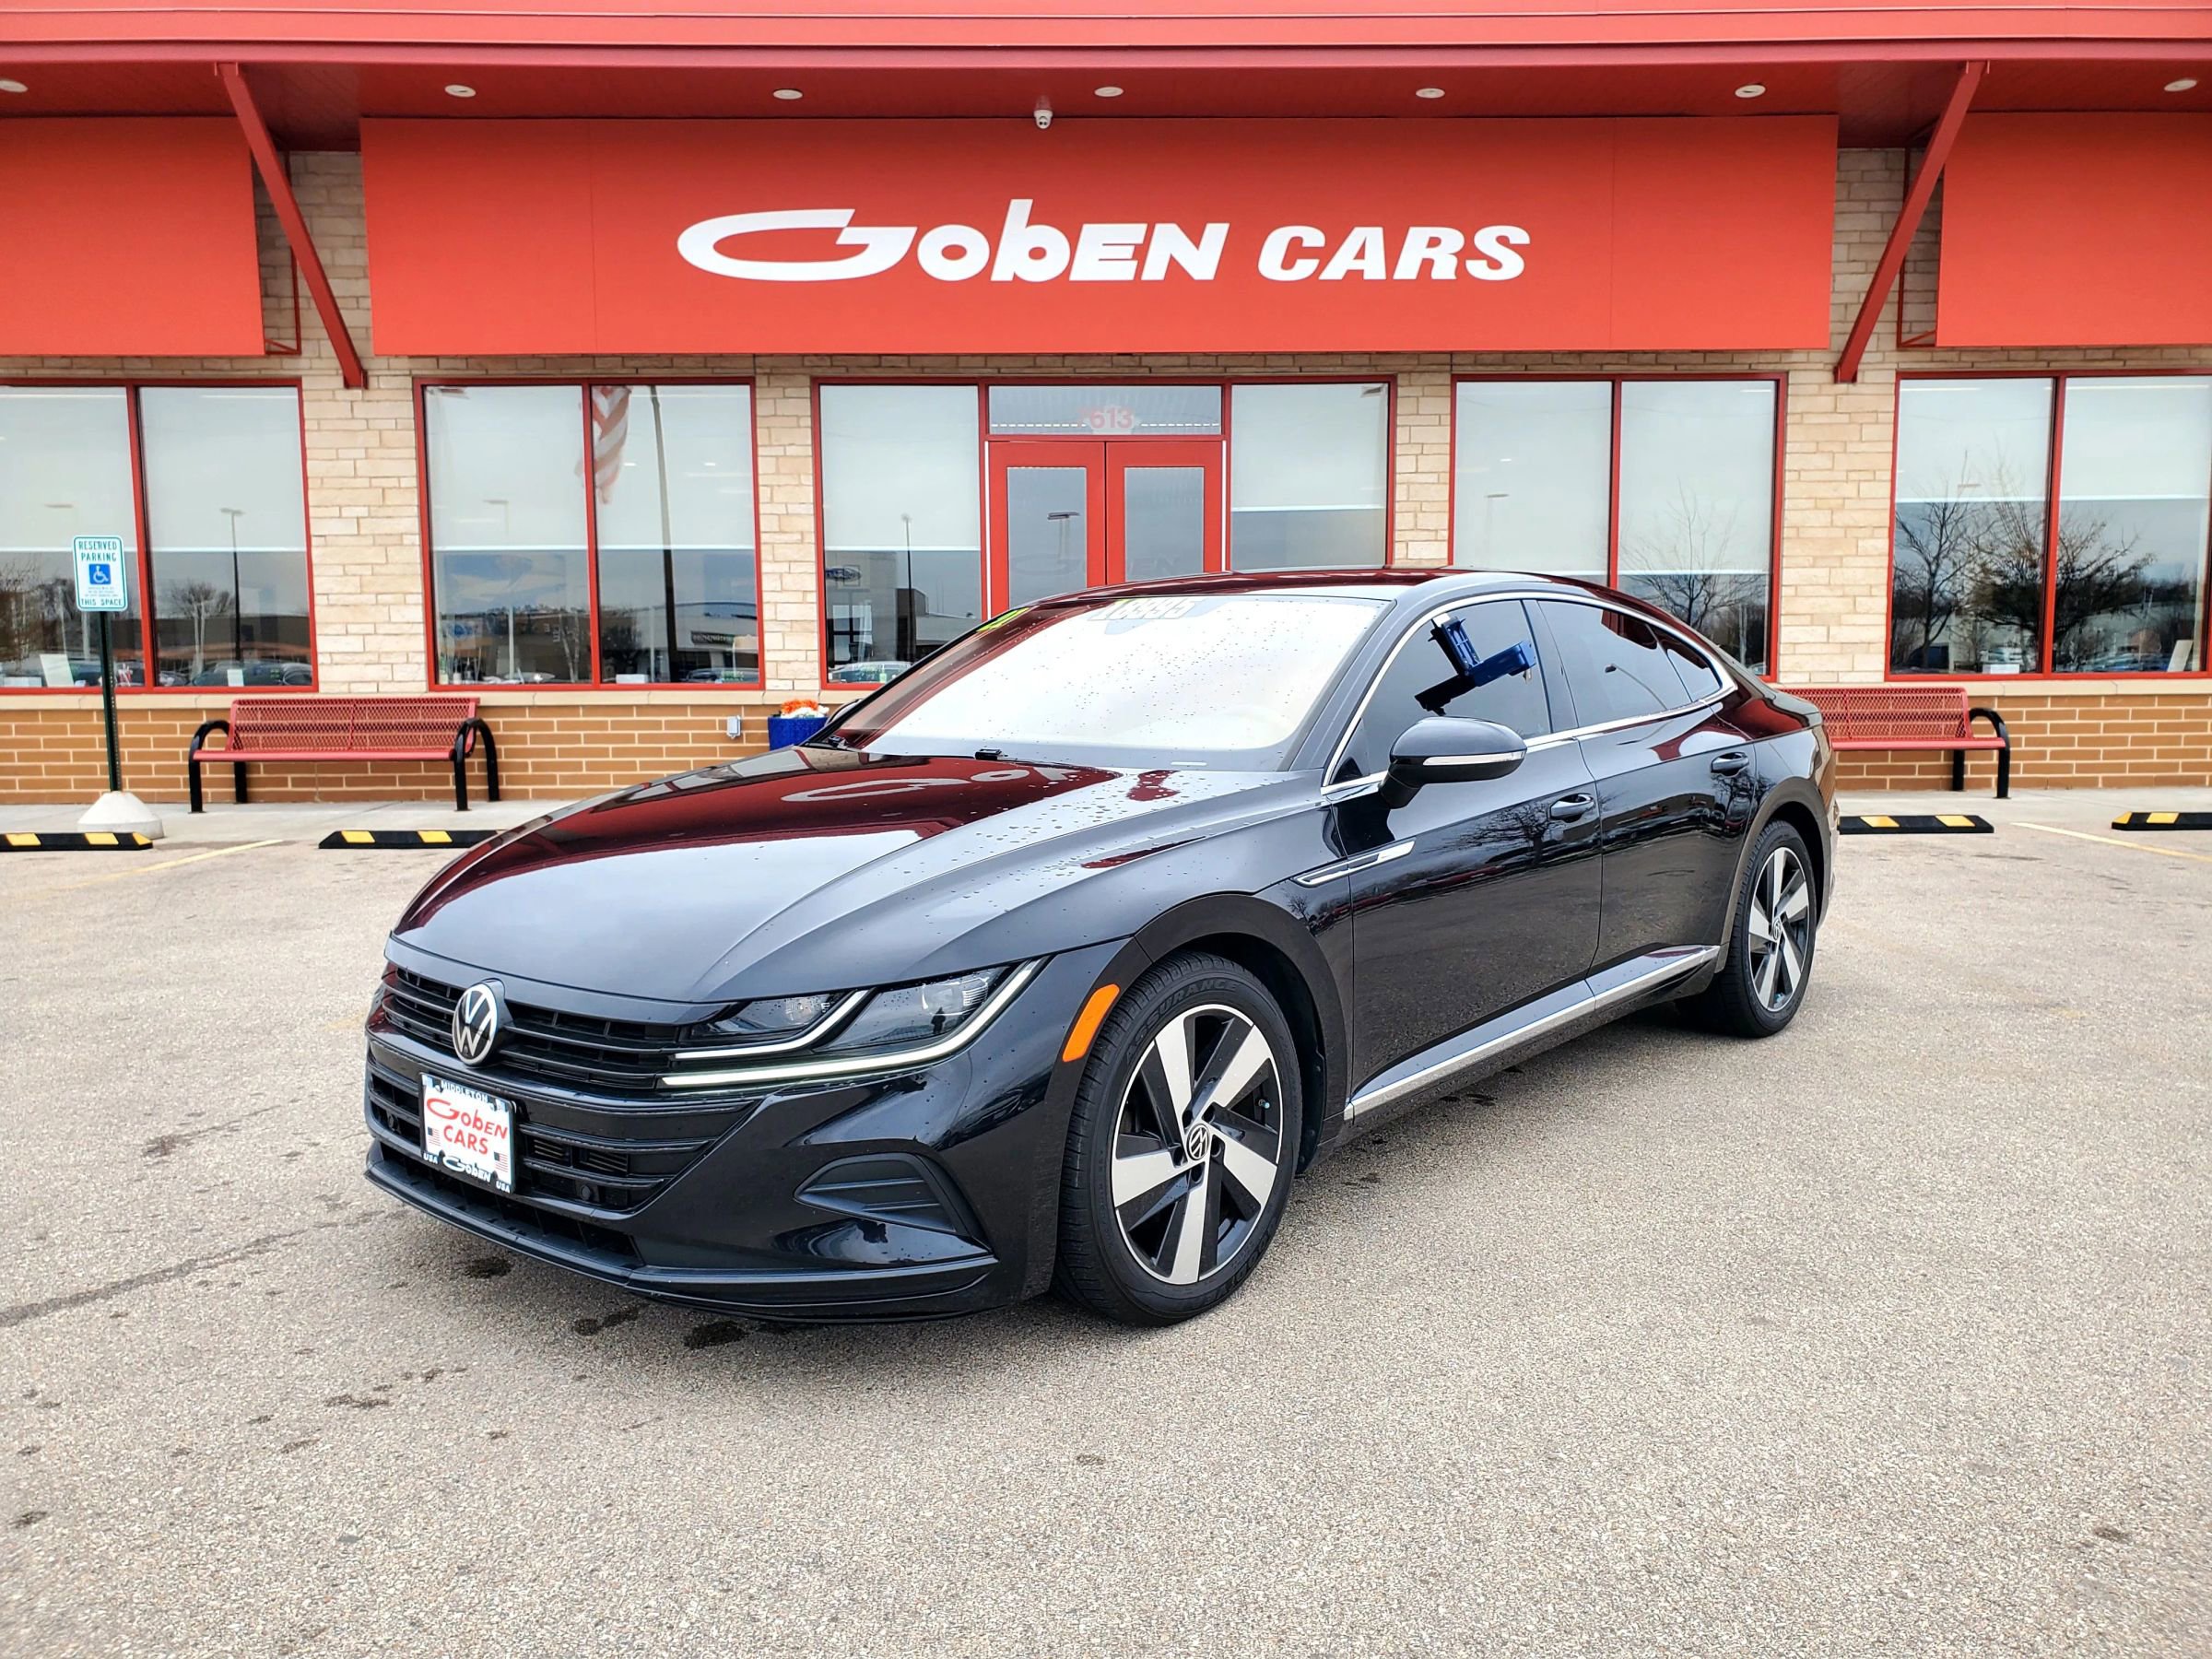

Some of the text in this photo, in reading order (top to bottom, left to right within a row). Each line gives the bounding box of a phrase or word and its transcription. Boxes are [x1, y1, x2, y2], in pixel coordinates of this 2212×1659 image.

[1258, 226, 1530, 281] CARS
[78, 540, 117, 550] RESERVED
[81, 553, 116, 561] PARKING
[1124, 979, 1238, 1066] ASSURANCE
[441, 1079, 488, 1103] MIDDLETON
[443, 1124, 488, 1155] CARS
[423, 1153, 438, 1164] USA
[496, 1181, 511, 1194] USA
